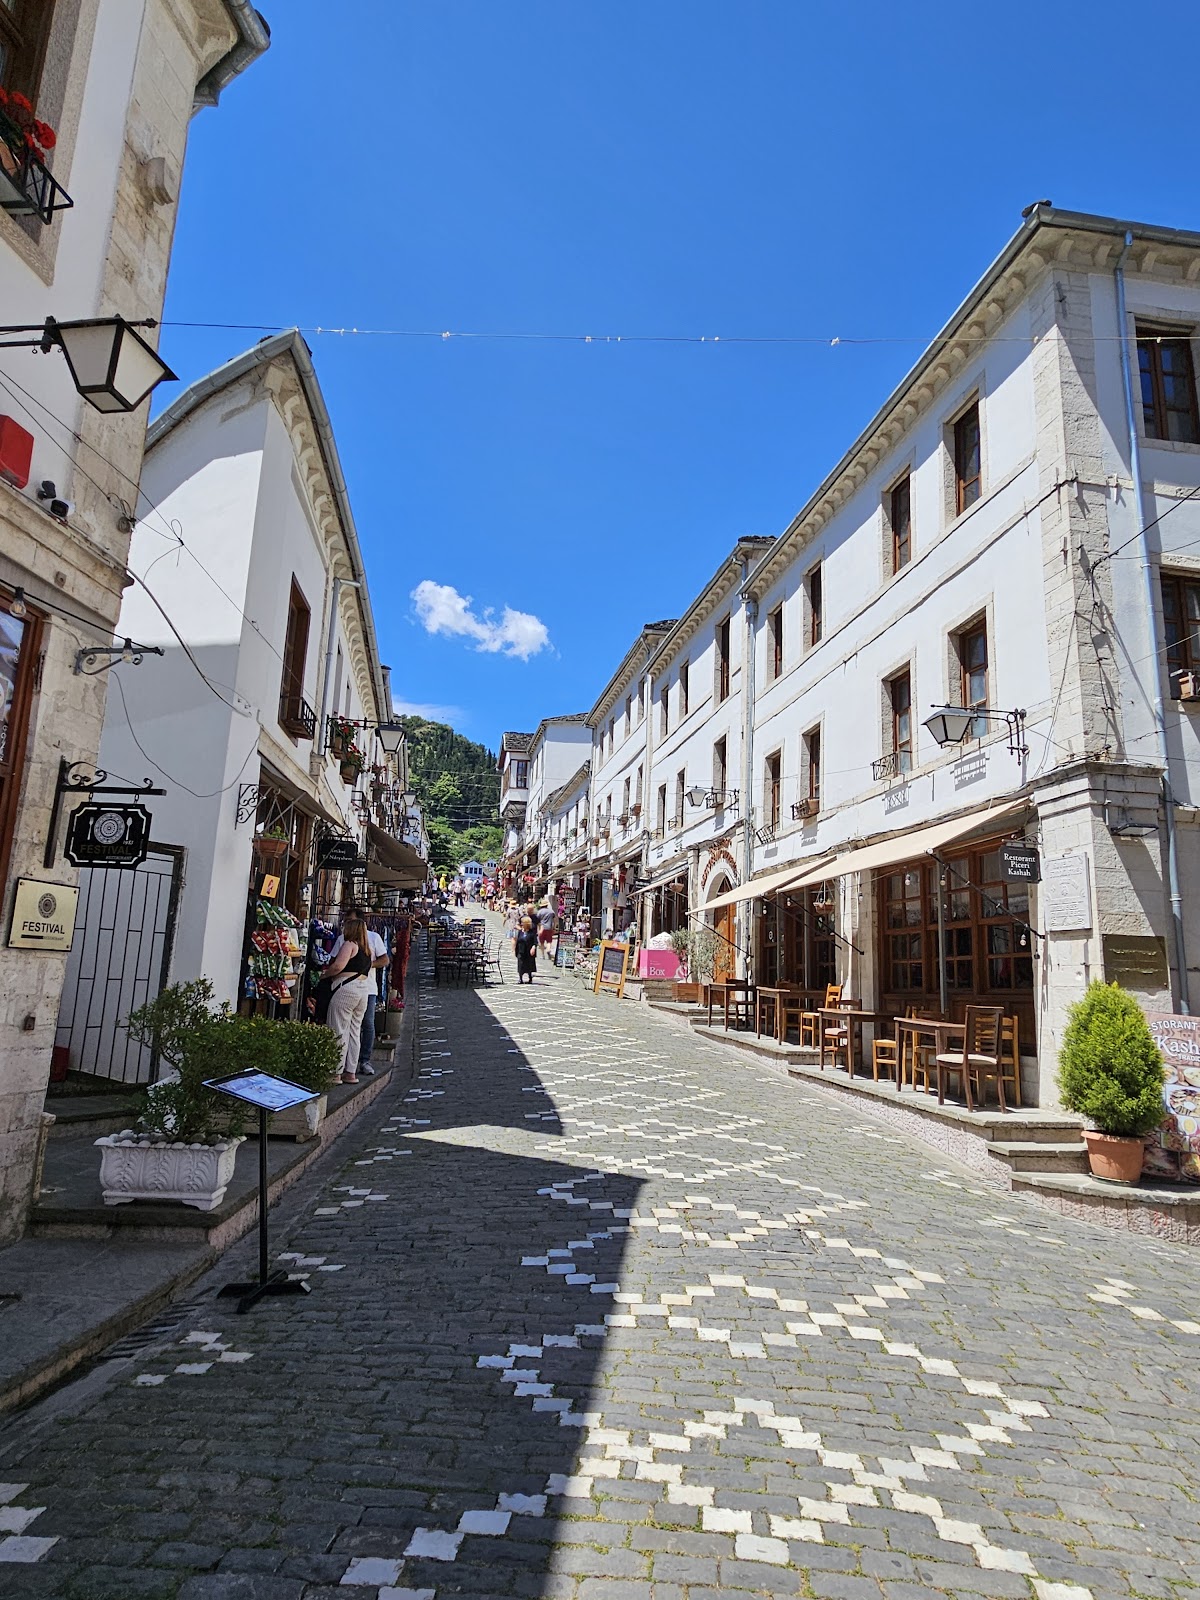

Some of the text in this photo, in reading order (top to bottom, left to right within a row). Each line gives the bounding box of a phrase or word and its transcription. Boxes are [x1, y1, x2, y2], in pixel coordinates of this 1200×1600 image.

[80, 844, 132, 855] FESTIVAL
[1004, 852, 1036, 862] Restorant
[1010, 860, 1031, 869] Piceri
[1008, 868, 1032, 877] Kashah
[22, 921, 65, 935] FESTIVAL
[649, 966, 666, 976] Box
[1152, 1035, 1200, 1057] Kash
